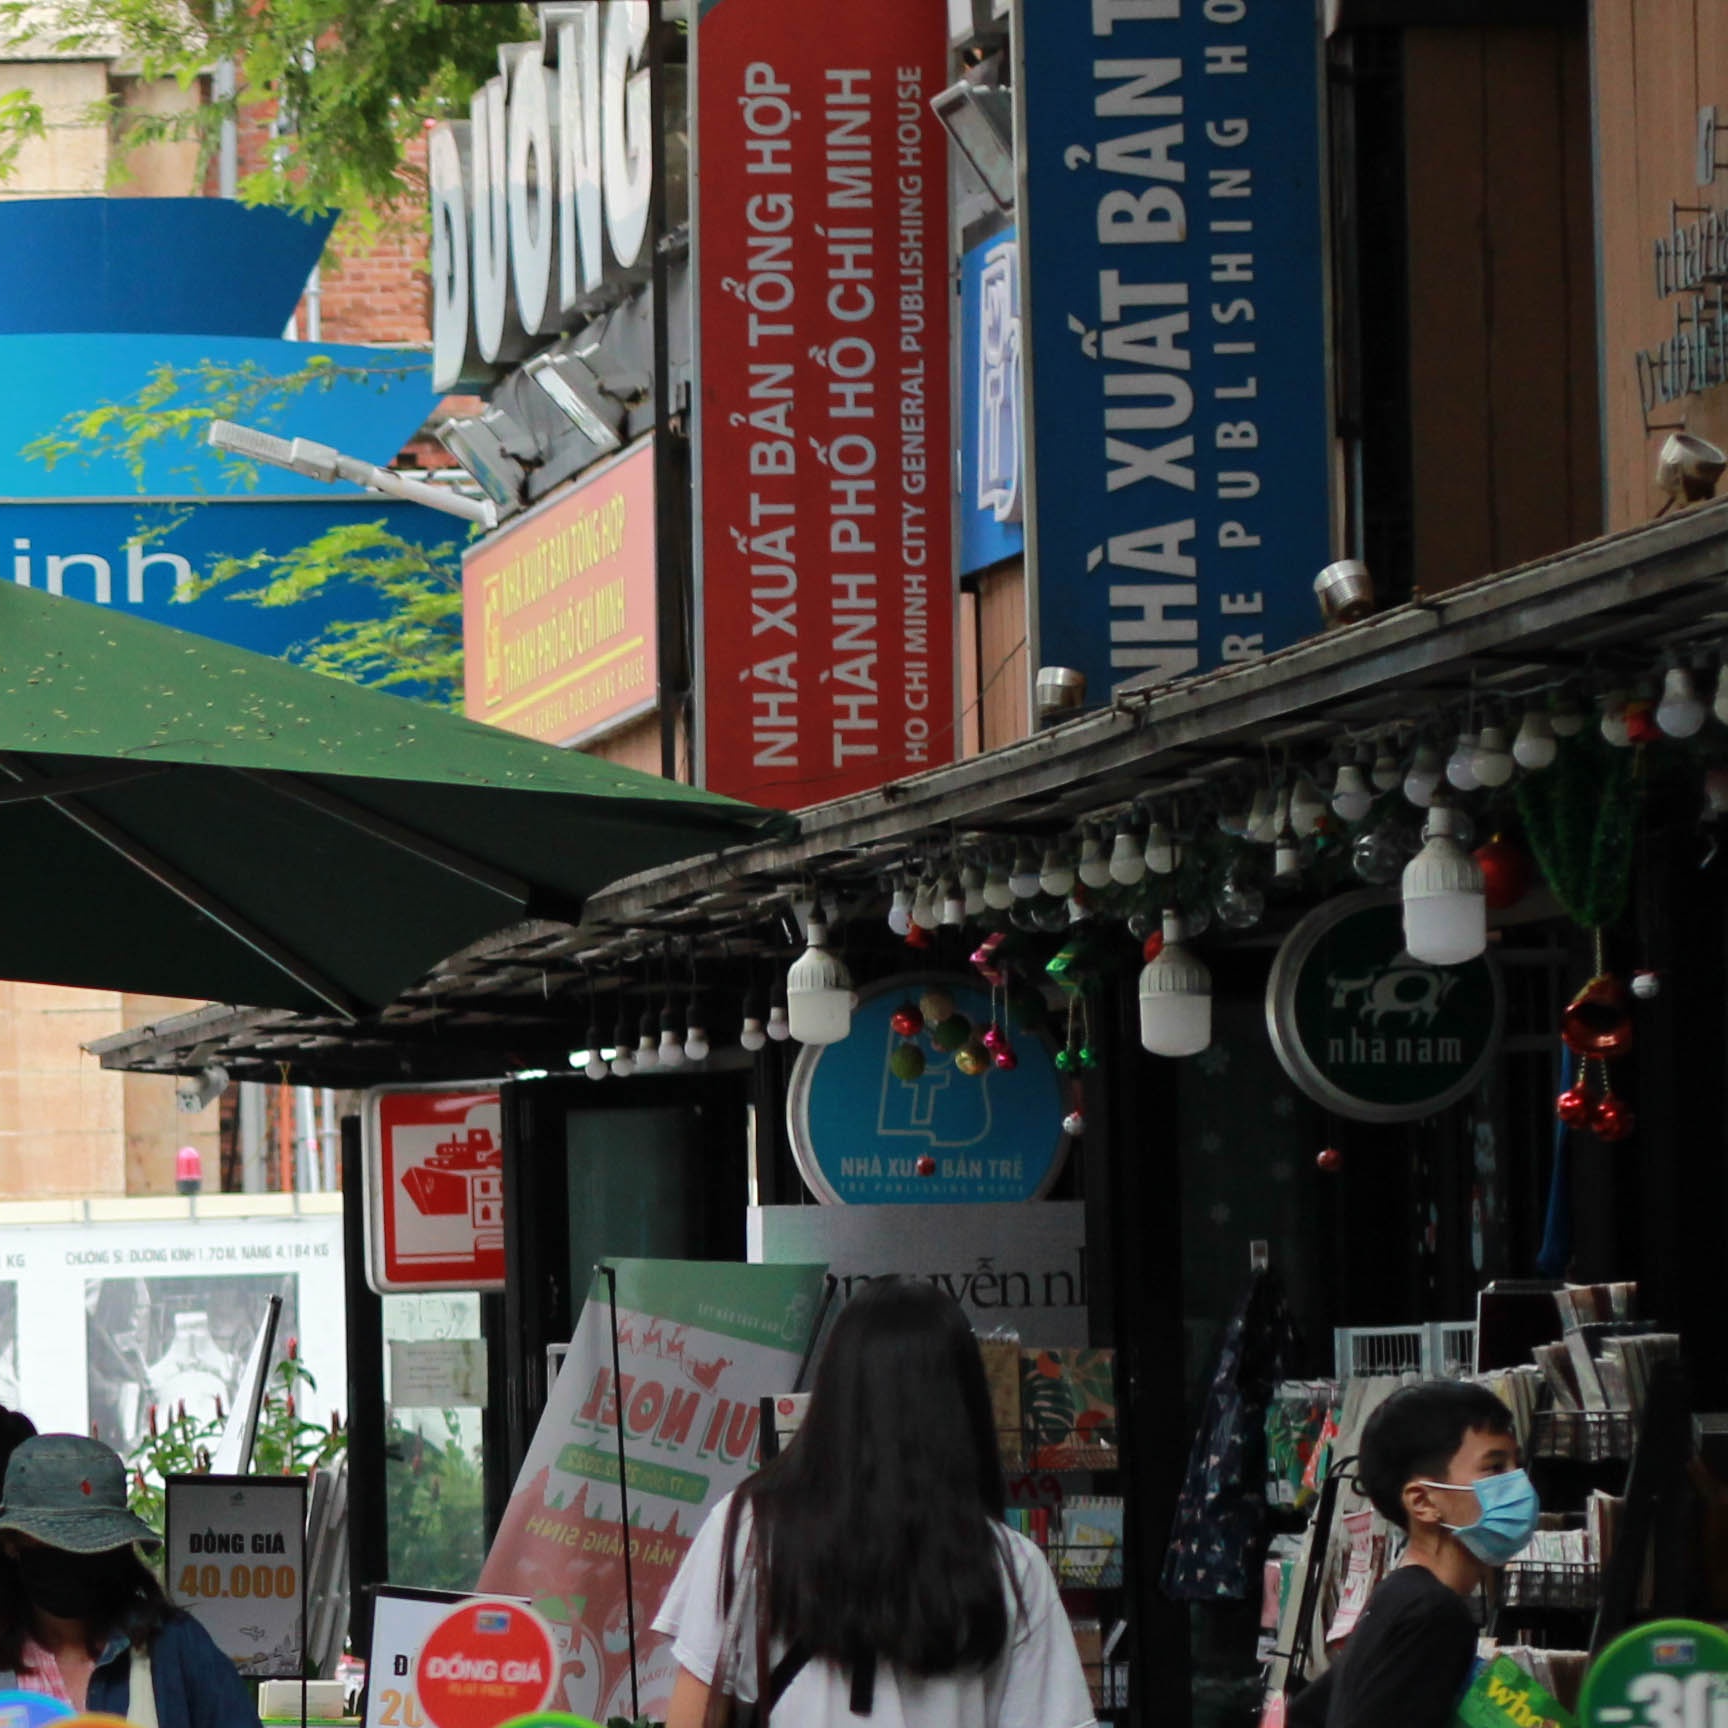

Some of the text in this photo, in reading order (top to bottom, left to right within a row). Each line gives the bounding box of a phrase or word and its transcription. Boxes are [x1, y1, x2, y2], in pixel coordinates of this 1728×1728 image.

[1064, 57, 1186, 244] BẢN
[1207, 117, 1262, 548] PUBLISHING
[1068, 269, 1195, 491] XUẤT
[722, 61, 798, 767] NHÀ XUẤT BẢN TỔNG HỢP
[808, 68, 879, 768] THÀNH PHỐ HỒ CHÍ MINH
[896, 66, 929, 762] HO CHI MINH CITY GENERAL PUBLISHING HOUSE
[1395, 1036, 1462, 1063] nam
[840, 1153, 882, 1178] NHÀ
[886, 1150, 936, 1178] XU
[942, 1151, 982, 1178] BẢN
[6, 1253, 26, 1268] KG
[314, 1242, 330, 1256] KG
[842, 1256, 1031, 1309] yễn
[250, 1529, 286, 1554] GIÁ
[178, 1564, 296, 1599] 40.000
[500, 1657, 543, 1684] GIÁ
